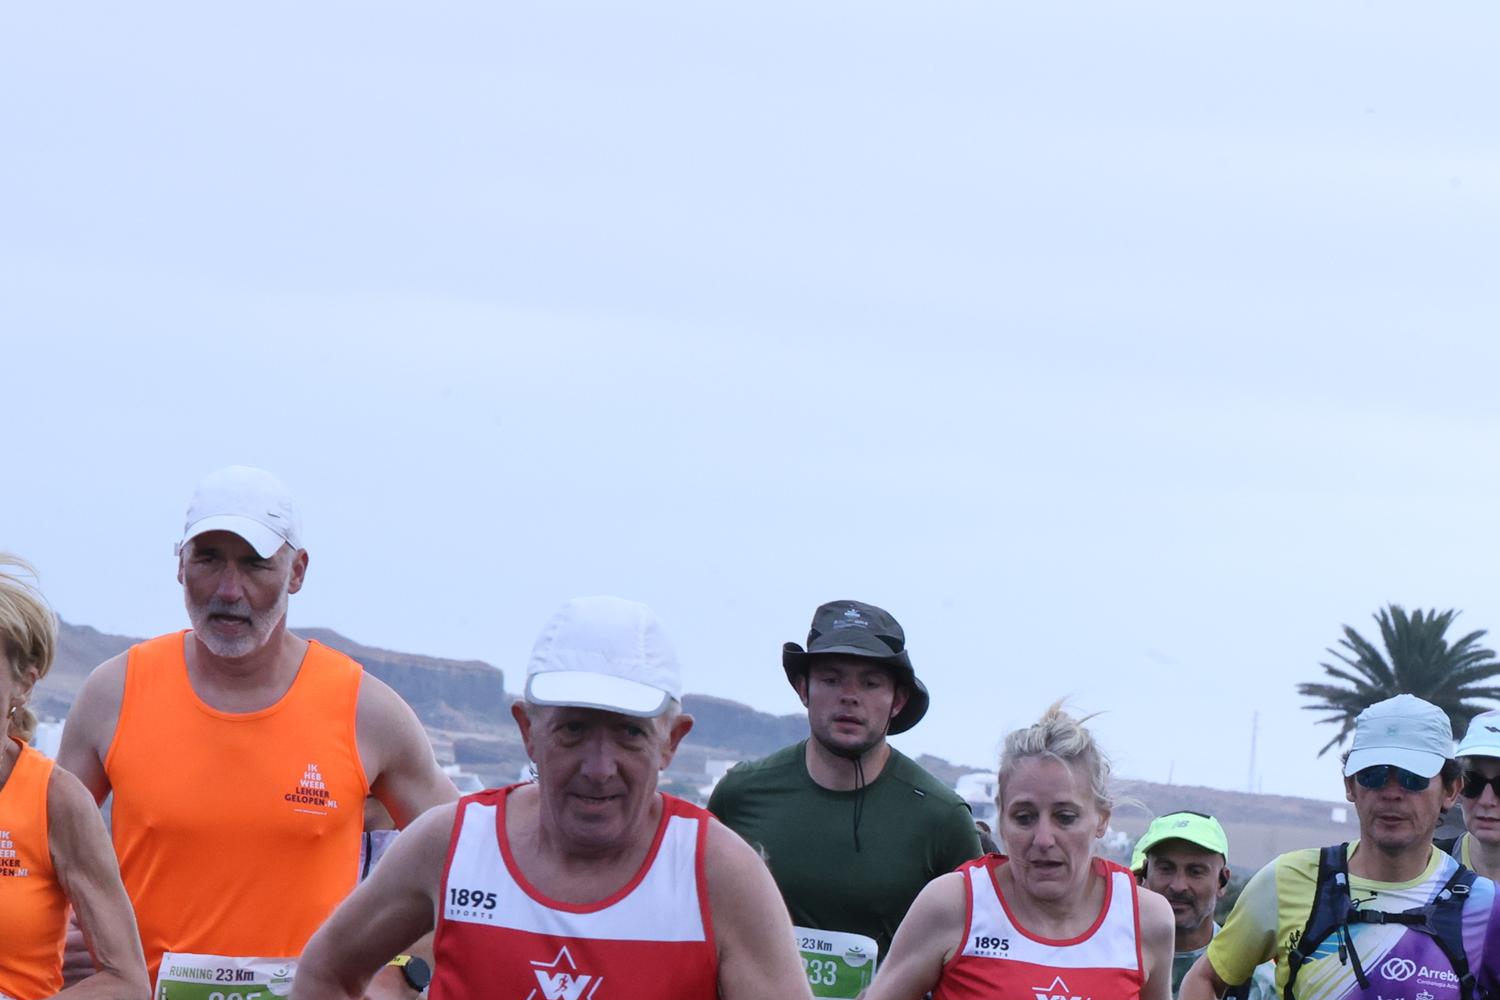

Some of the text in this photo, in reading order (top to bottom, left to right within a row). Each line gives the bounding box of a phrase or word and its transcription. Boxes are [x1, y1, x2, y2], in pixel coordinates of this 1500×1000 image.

[307, 763, 318, 772] IK
[303, 771, 322, 781] HEB
[299, 779, 326, 790] WEER
[295, 787, 330, 799] LEKKER
[284, 793, 338, 808] GELOPEN.NL
[0, 840, 14, 849] EB
[0, 849, 16, 858] EER
[0, 859, 21, 868] KER
[450, 888, 497, 910] 1895
[802, 937, 833, 952] 23 Km
[975, 936, 1010, 951] 1895
[169, 965, 214, 980] RUNNING
[215, 968, 234, 982] 23
[235, 969, 255, 982] Km
